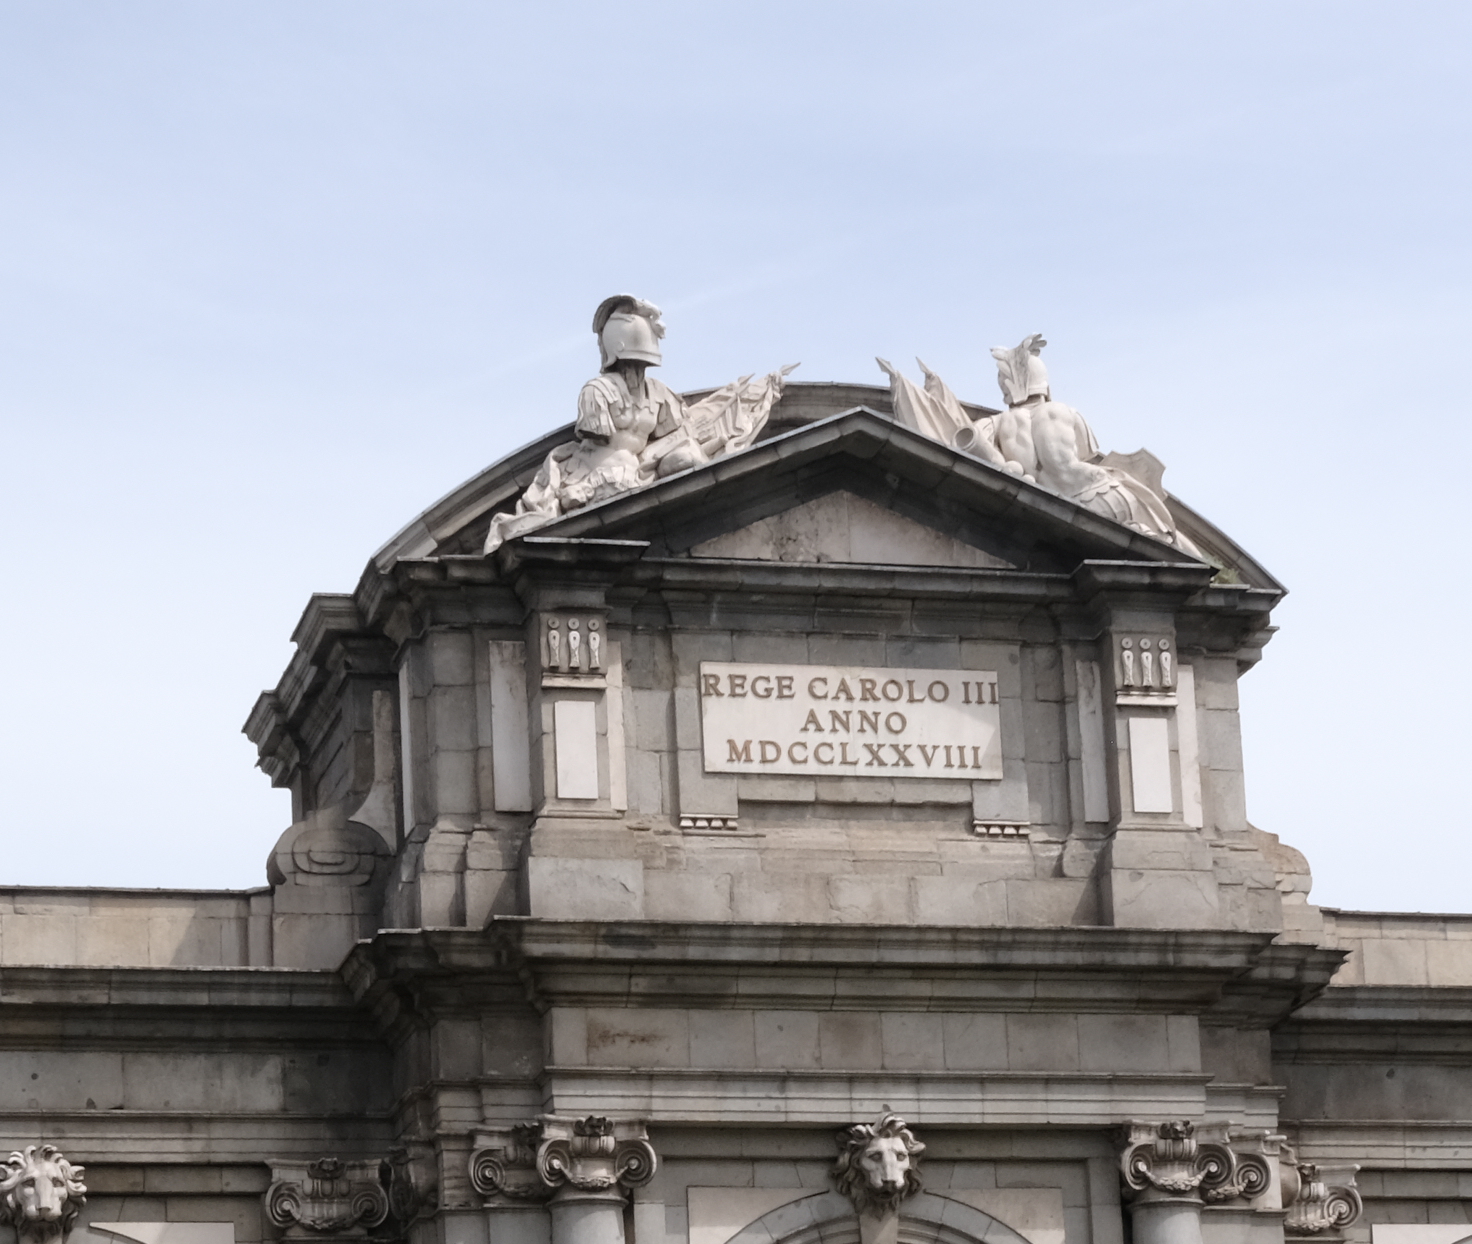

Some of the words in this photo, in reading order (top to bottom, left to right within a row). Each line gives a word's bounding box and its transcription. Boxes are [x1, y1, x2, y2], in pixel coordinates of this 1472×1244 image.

[702, 673, 796, 699] REGE
[807, 677, 950, 704] CAROLO
[962, 681, 999, 705] III
[799, 708, 908, 735] ANNO
[726, 739, 982, 769] MDCCLXXVIII
